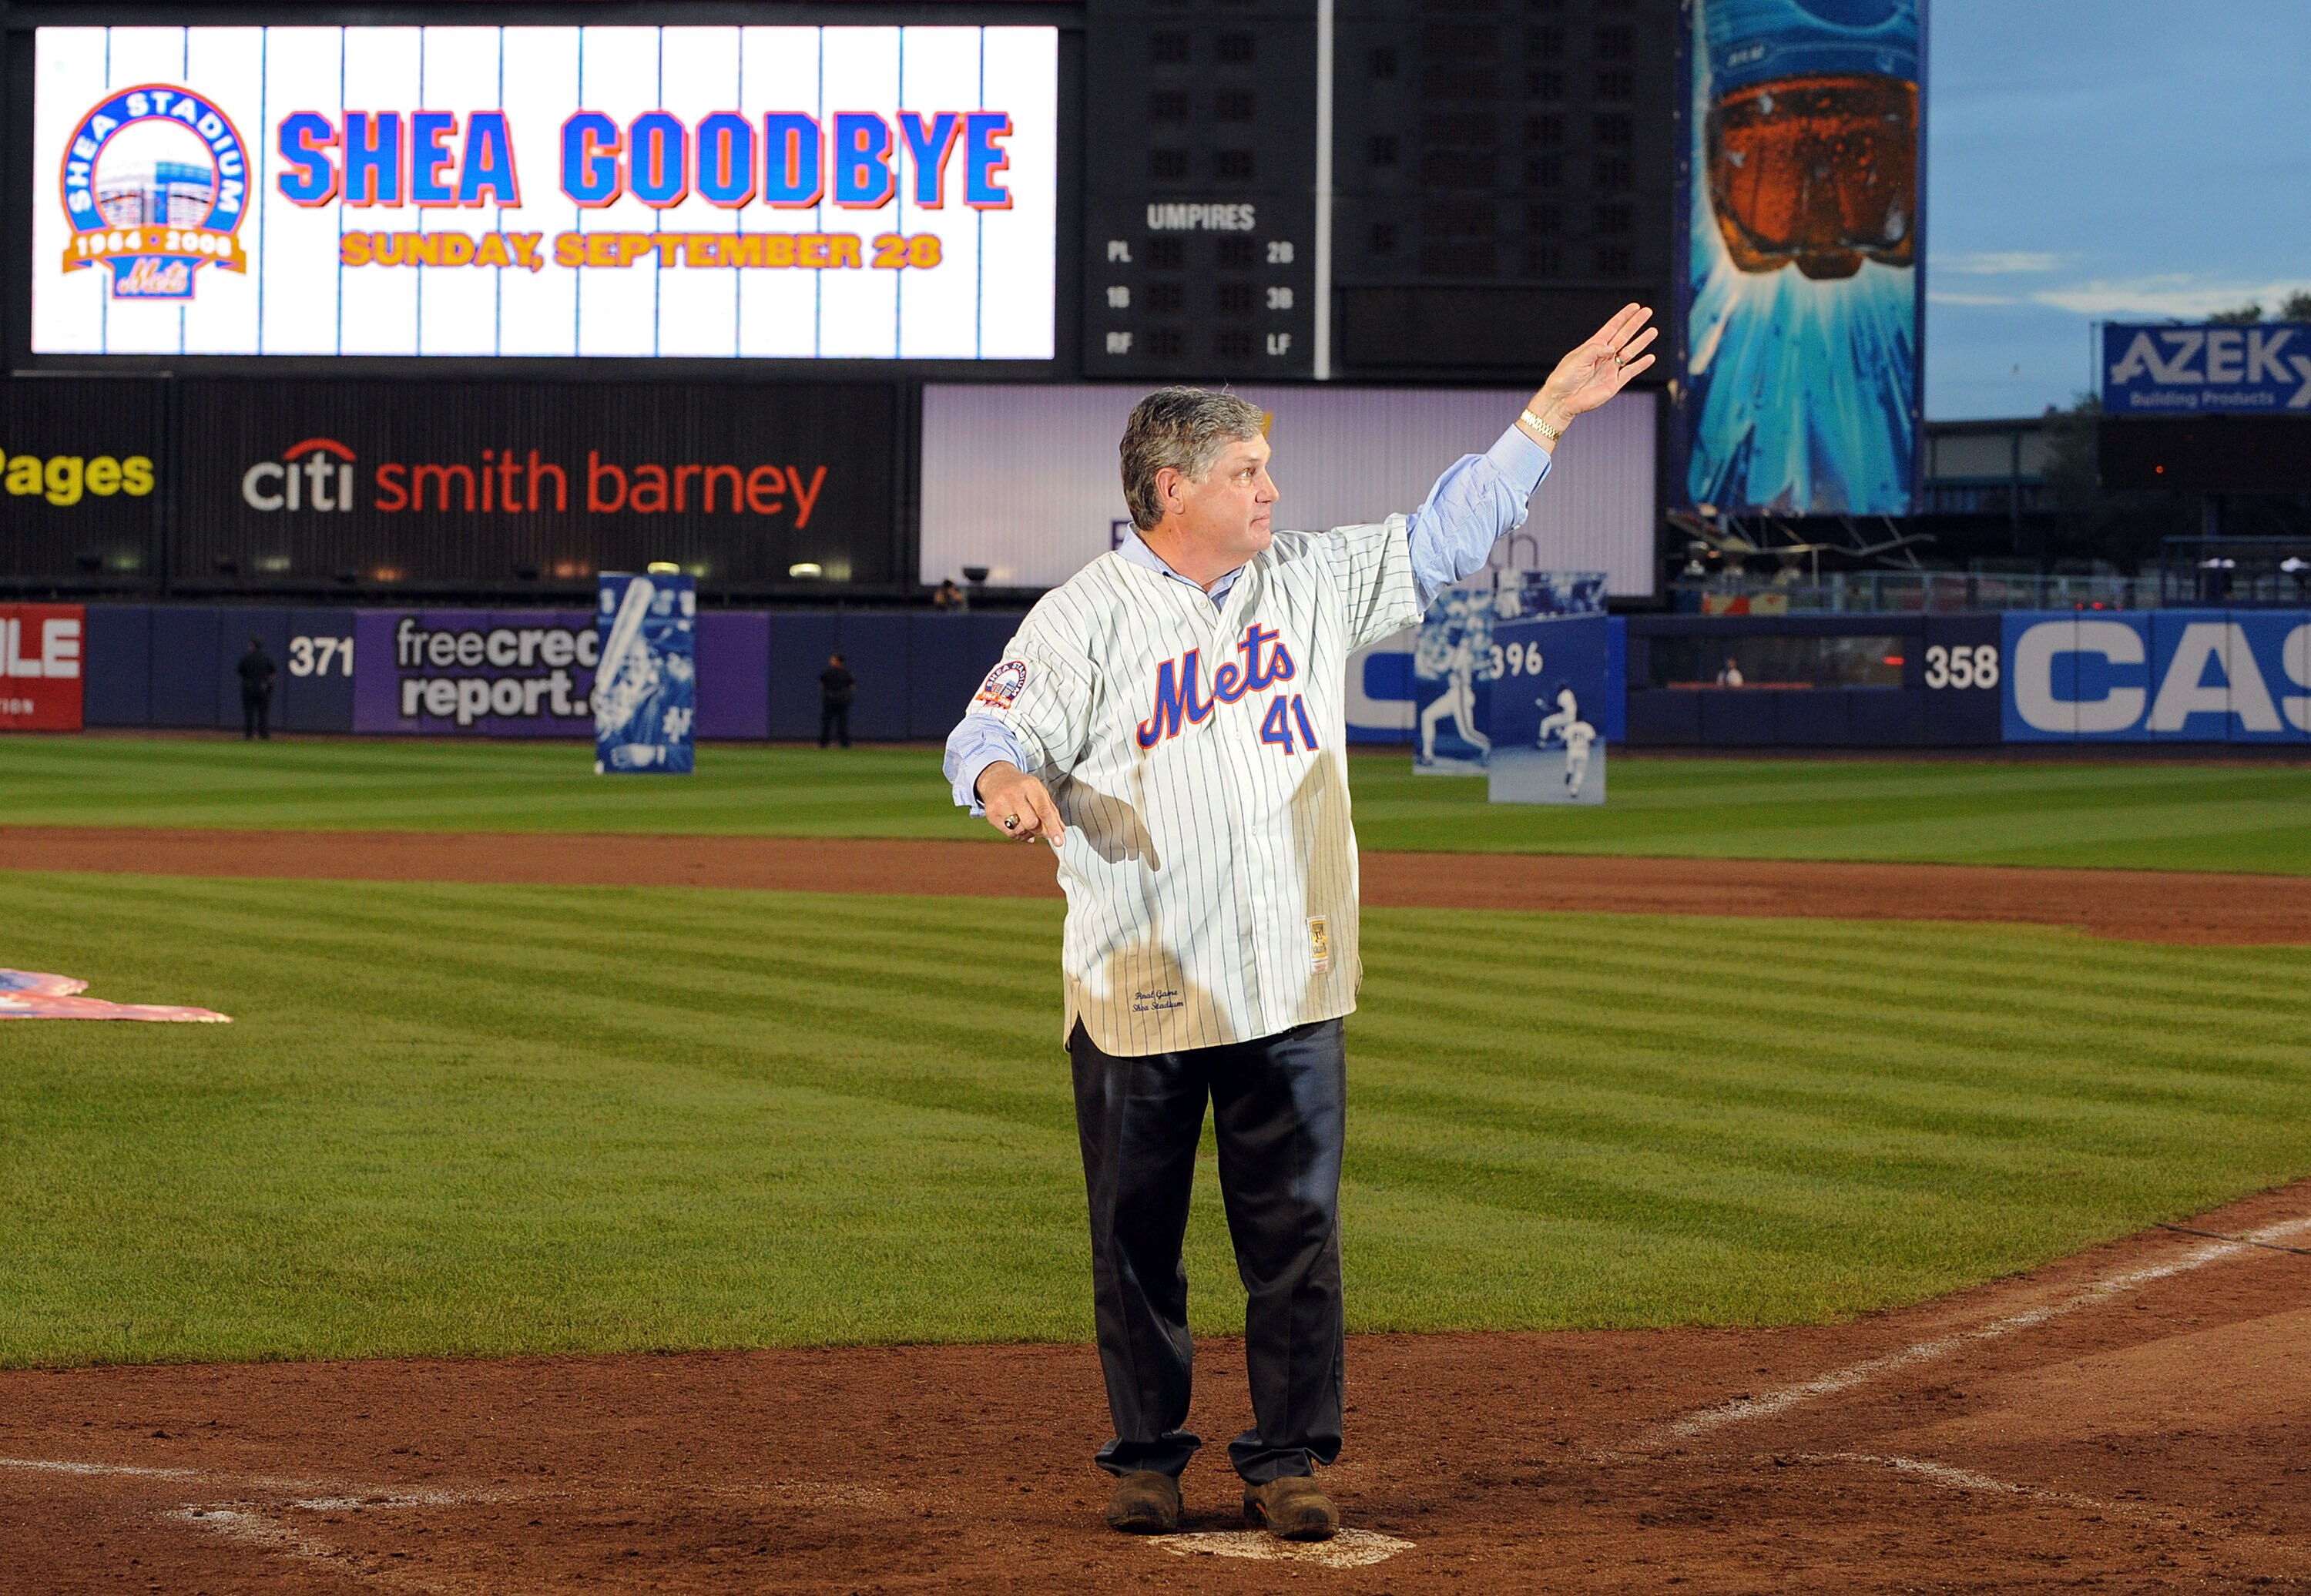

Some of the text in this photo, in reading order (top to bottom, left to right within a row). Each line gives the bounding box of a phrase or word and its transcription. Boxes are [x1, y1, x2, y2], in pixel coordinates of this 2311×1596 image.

[66, 90, 245, 215] SHEA STADIUM
[277, 109, 1013, 210] SHEA GOODBYE
[1146, 203, 1256, 231] UMPIRES
[339, 231, 942, 273] SUNDAY, SEPTEMBER 28
[1107, 240, 1132, 263] PL
[1266, 332, 1292, 356] LF
[2111, 329, 2294, 384] AZEK
[0, 447, 154, 506] ages
[242, 449, 827, 529] citi smith barney
[0, 619, 81, 679] LE
[288, 635, 354, 677] 371
[1489, 640, 1544, 680] 396
[1924, 645, 2000, 689] 358
[1136, 623, 1296, 749] Mets
[2012, 620, 2311, 733] CA
[1259, 693, 1320, 756] 41
[1132, 1001, 1184, 1012] Shea Stadium
[1156, 989, 1178, 1000] Game
